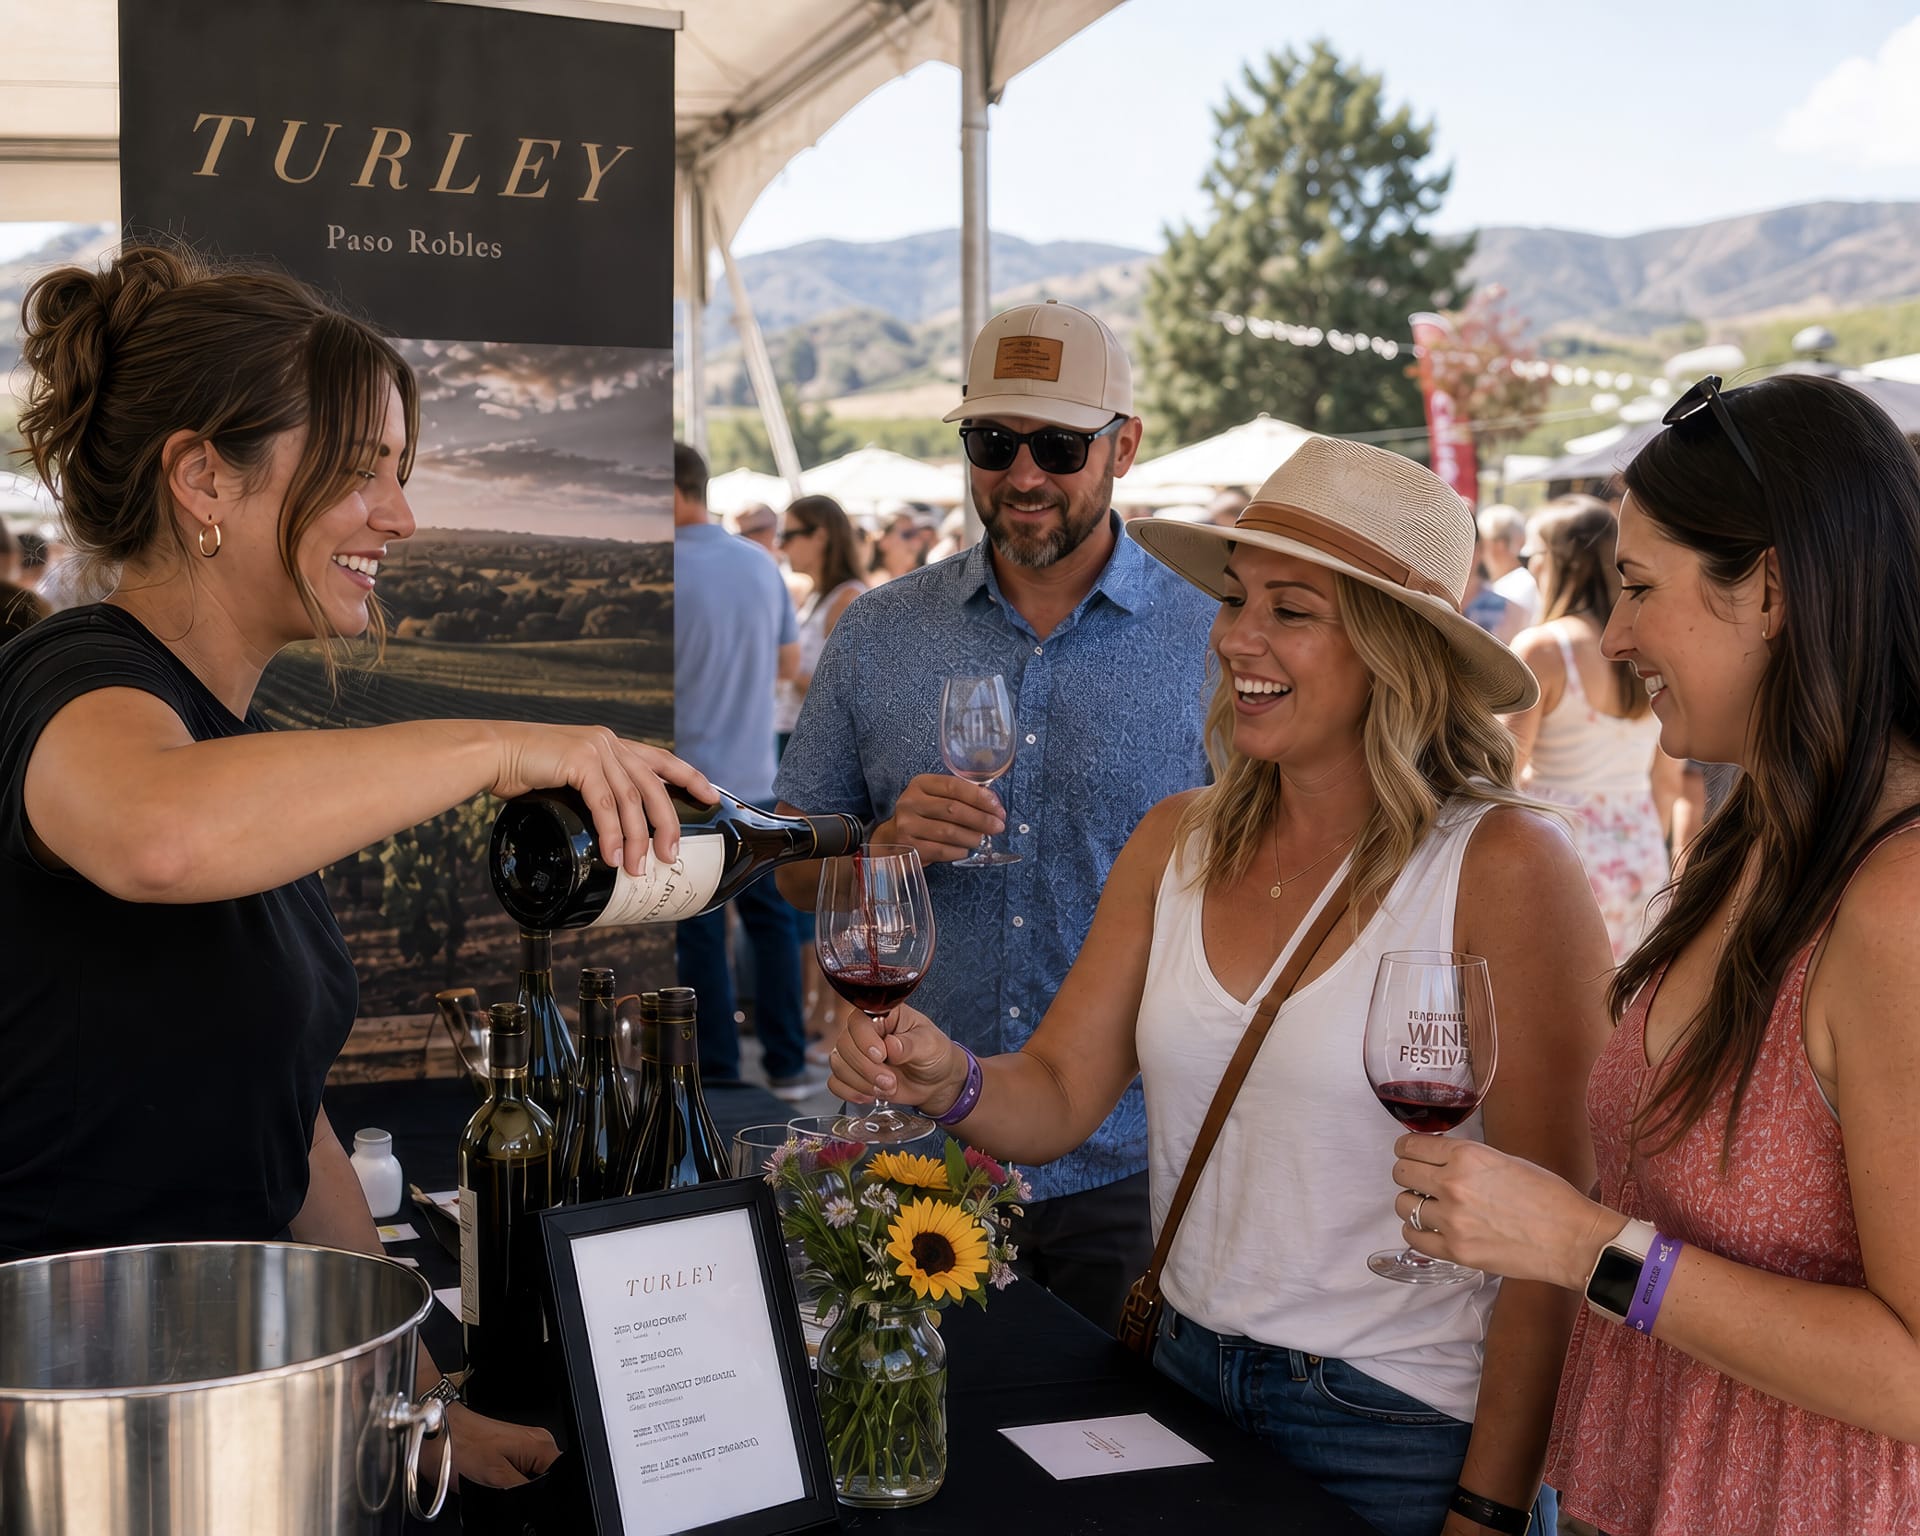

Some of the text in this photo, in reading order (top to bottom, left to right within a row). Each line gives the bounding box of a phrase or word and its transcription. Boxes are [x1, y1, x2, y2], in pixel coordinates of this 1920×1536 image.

[191, 112, 634, 202] TURLEY
[326, 224, 503, 260] Paso Robles
[626, 1263, 717, 1297] TURLEY
